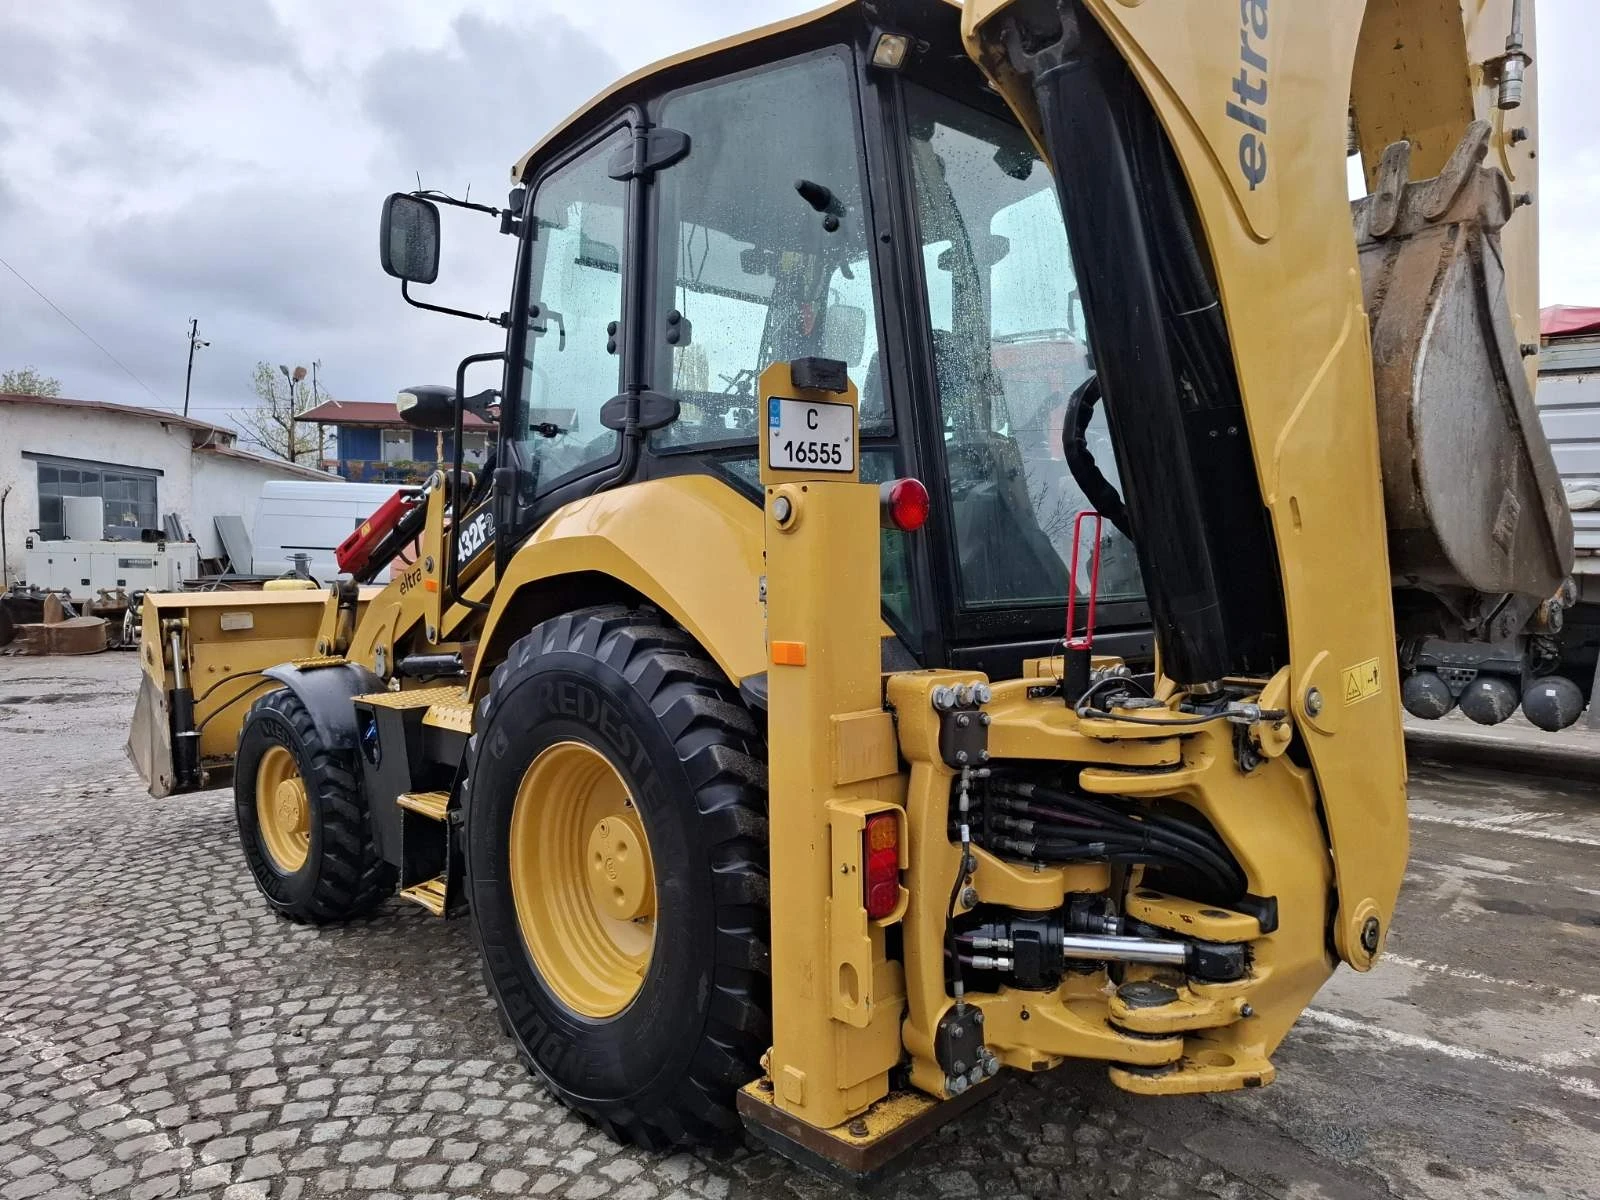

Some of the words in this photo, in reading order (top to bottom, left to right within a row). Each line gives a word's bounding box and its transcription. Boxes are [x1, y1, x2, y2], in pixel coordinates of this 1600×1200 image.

[1226, 0, 1268, 191] eltra
[807, 409, 818, 430] C
[784, 441, 842, 464] 16555
[400, 568, 422, 595] eltra
